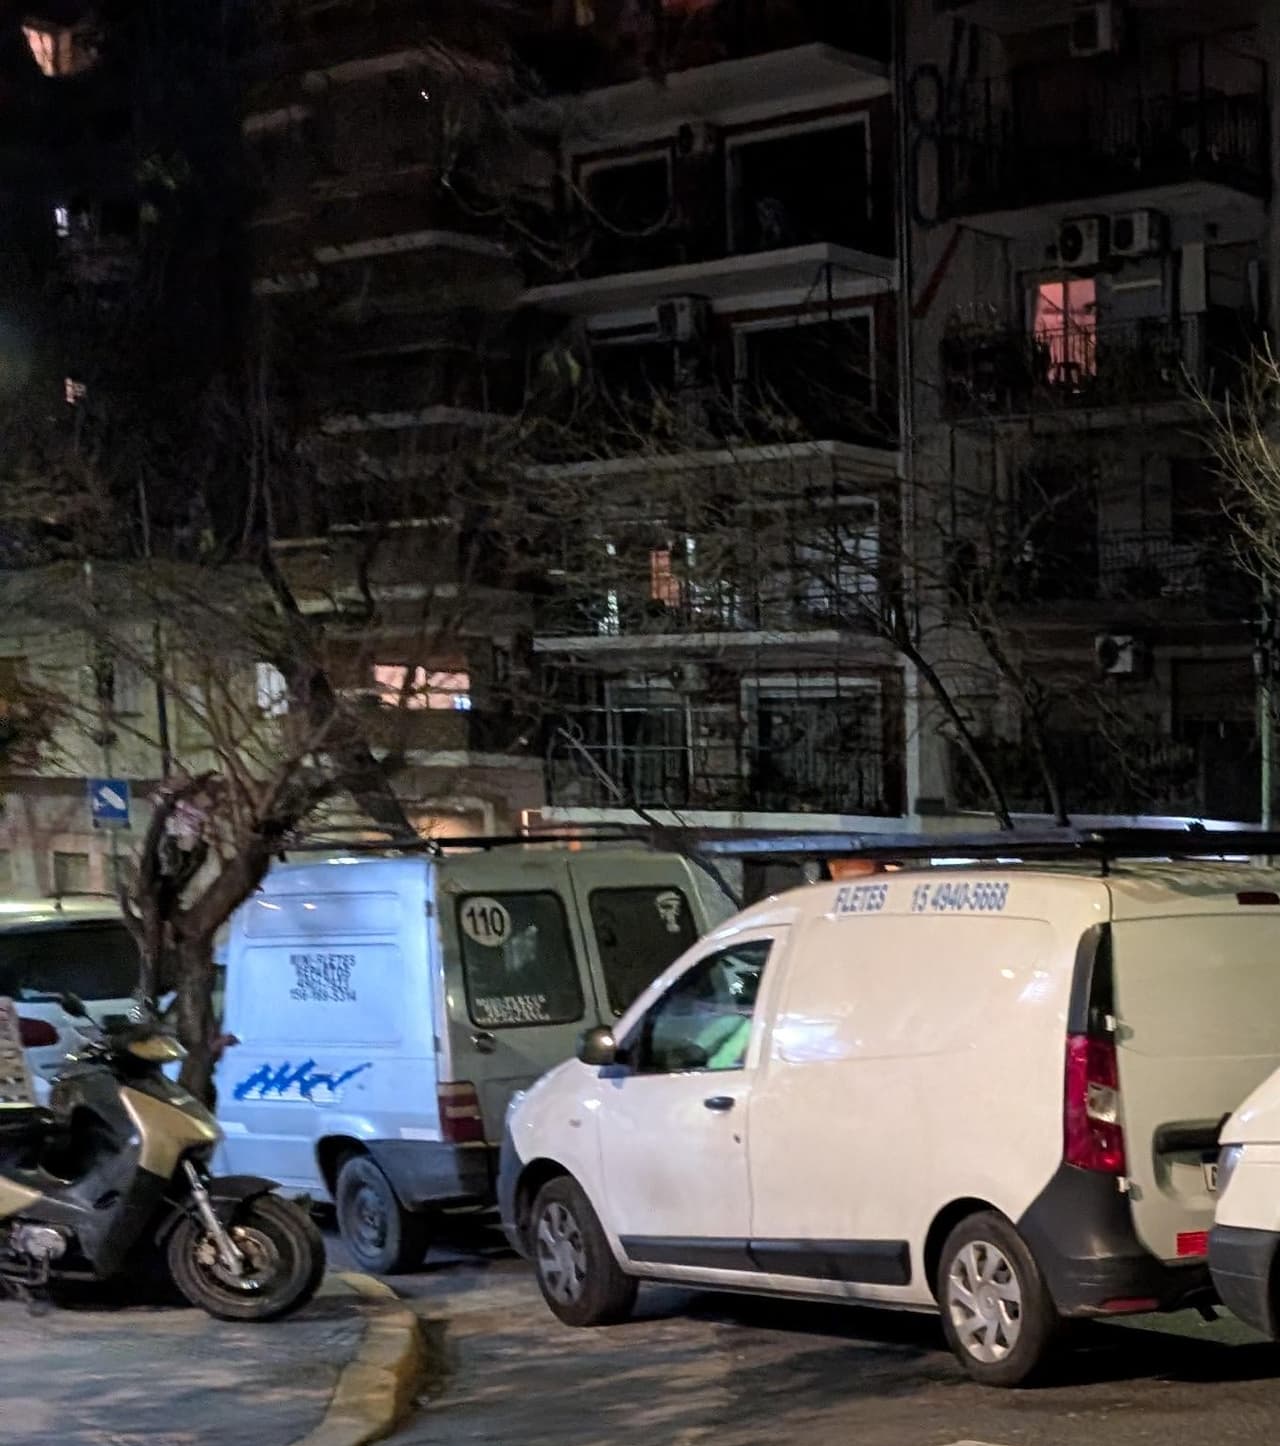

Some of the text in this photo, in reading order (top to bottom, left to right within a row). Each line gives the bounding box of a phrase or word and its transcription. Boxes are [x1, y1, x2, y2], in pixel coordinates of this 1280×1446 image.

[834, 884, 888, 912] FLETES
[911, 883, 931, 911] 15
[466, 907, 505, 936] 110
